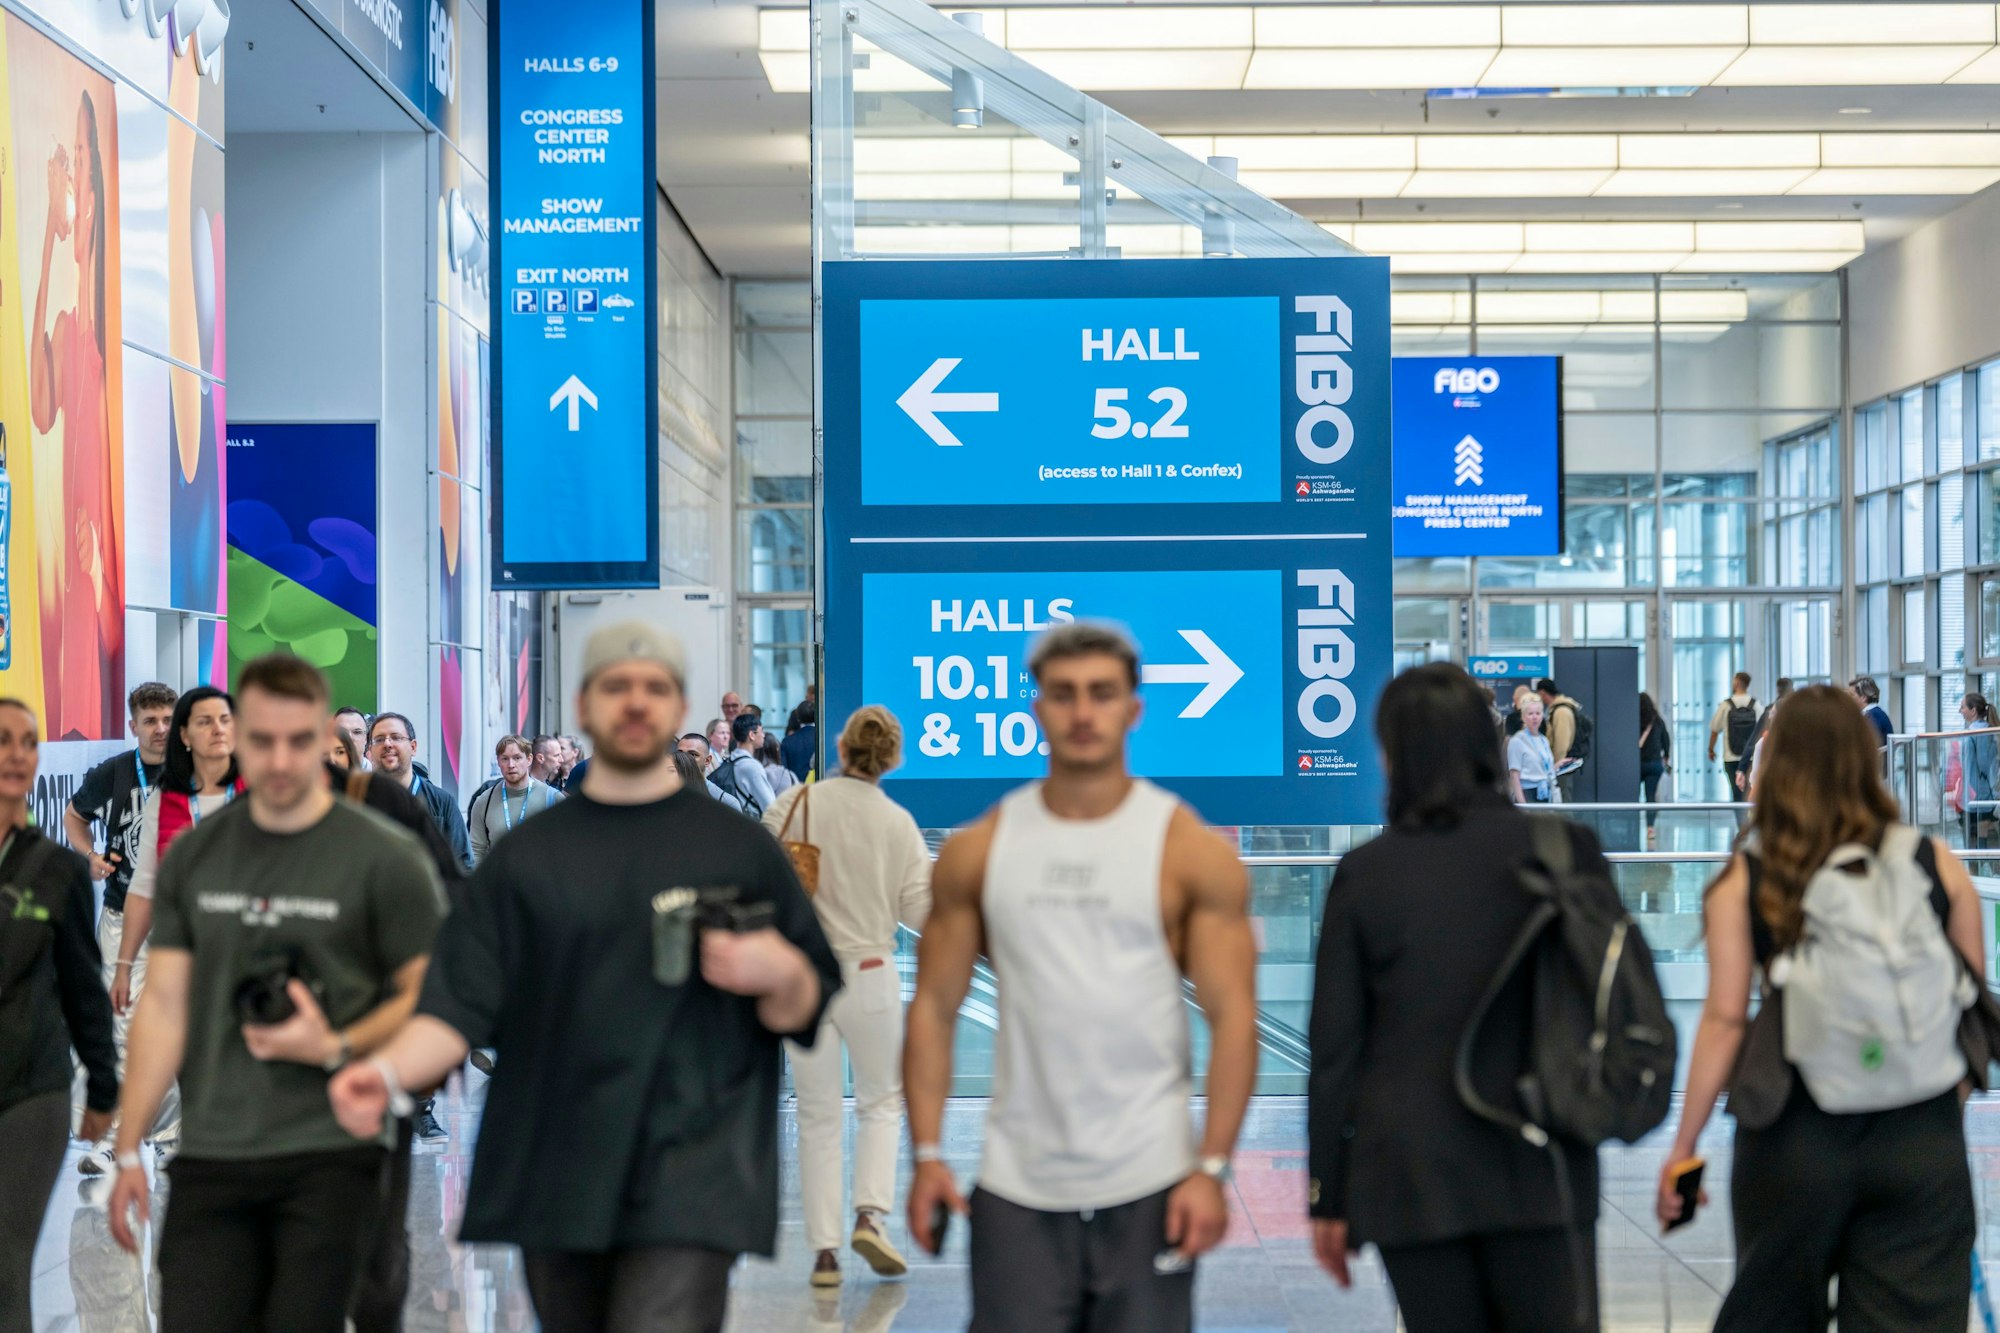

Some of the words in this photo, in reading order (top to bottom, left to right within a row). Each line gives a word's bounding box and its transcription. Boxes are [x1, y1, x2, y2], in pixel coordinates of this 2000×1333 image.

[429, 0, 456, 104] FIBO
[524, 57, 585, 73] HALLS
[588, 56, 619, 73] 6-9
[520, 109, 624, 125] CONGRESS
[534, 128, 609, 144] CENTER
[538, 148, 606, 164] NORTH
[541, 198, 603, 214] SHOW
[504, 217, 642, 233] MANAGEMENT
[516, 268, 558, 284] EXIT
[562, 267, 629, 283] NORTH
[1082, 328, 1200, 361] HALL
[1295, 295, 1355, 465] FIBO
[1434, 367, 1500, 394] FIBO
[1090, 386, 1189, 440] 5.2
[1038, 465, 1097, 481] (access
[1100, 466, 1118, 478] to
[1121, 464, 1152, 478] Hall
[1155, 464, 1162, 478] 1
[1165, 464, 1177, 478] &
[1181, 463, 1243, 480] Confex)
[1312, 481, 1342, 489] KSM-66
[1405, 494, 1443, 506] SHOW
[1444, 494, 1528, 506] MANAGEMENT
[1453, 505, 1499, 517] CENTER
[1501, 505, 1543, 517] NORTH
[1424, 517, 1462, 528] PRESS
[1463, 517, 1510, 528] CENTER
[931, 597, 1075, 632] HALLS
[1297, 568, 1357, 739] FIBO
[912, 655, 1008, 700] 10.1
[918, 712, 961, 757] &
[975, 711, 1051, 757] 10.
[1314, 755, 1344, 763] KSM-66
